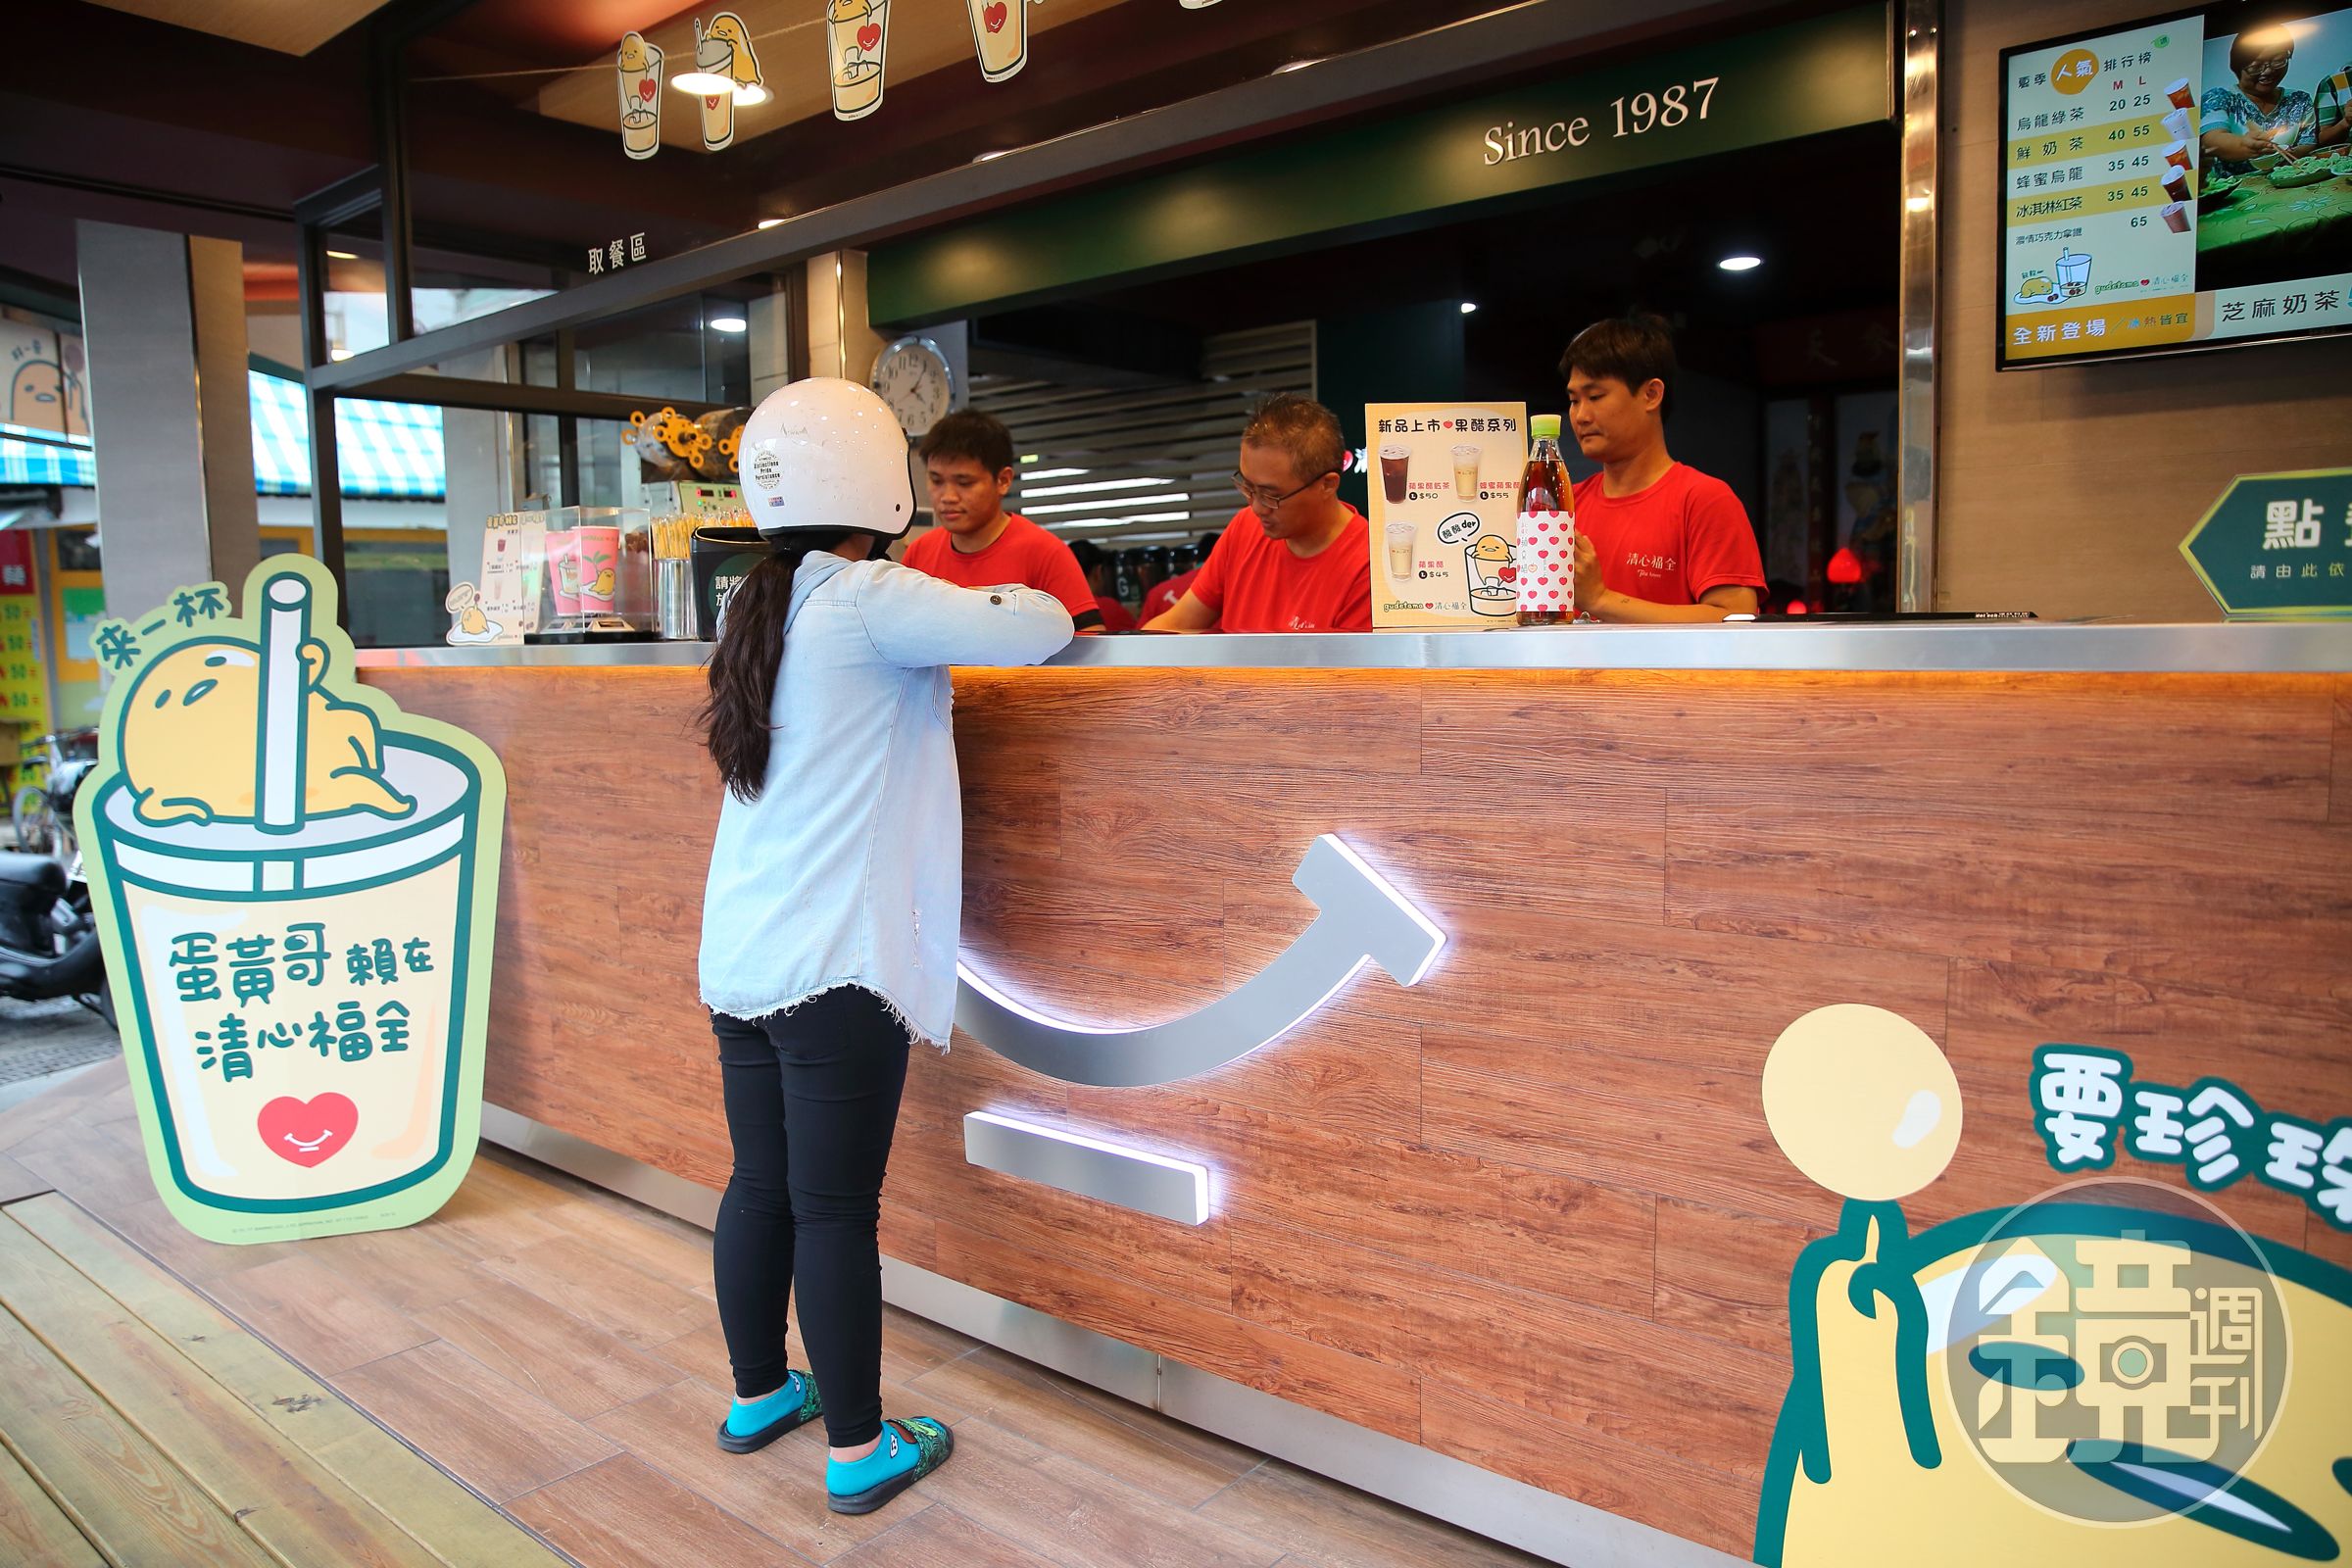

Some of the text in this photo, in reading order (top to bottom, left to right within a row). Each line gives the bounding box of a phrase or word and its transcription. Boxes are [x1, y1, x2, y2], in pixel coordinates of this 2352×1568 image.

[2018, 52, 2152, 89] 夏季 人氣 排行榜
[2113, 75, 2146, 90] M L
[1484, 76, 1719, 166] Since 1987
[2017, 94, 2151, 131] 烏龍綠茶 20 25
[2016, 124, 2150, 161] 鮮奶茶 40 55
[2016, 155, 2149, 189] 蜂蜜烏龍 35 45
[2016, 185, 2148, 218] 冰淇淋紅茶 35 45
[2131, 216, 2147, 227] 65
[588, 231, 647, 275] 取餐區
[2222, 290, 2340, 321] 芝麻奶茶
[2013, 318, 2106, 345] 全新登場
[1378, 418, 1516, 432] 新品上市 果醋系列
[2263, 499, 2352, 550] 點
[1627, 552, 1677, 571] 清心福全
[2250, 562, 2344, 579] 請由此依
[1384, 601, 1467, 612] gudetama 清心福全
[96, 588, 224, 670] 來一杯
[169, 922, 434, 1008] 蛋黃哥 賴在
[195, 1000, 410, 1083] 清心福全
